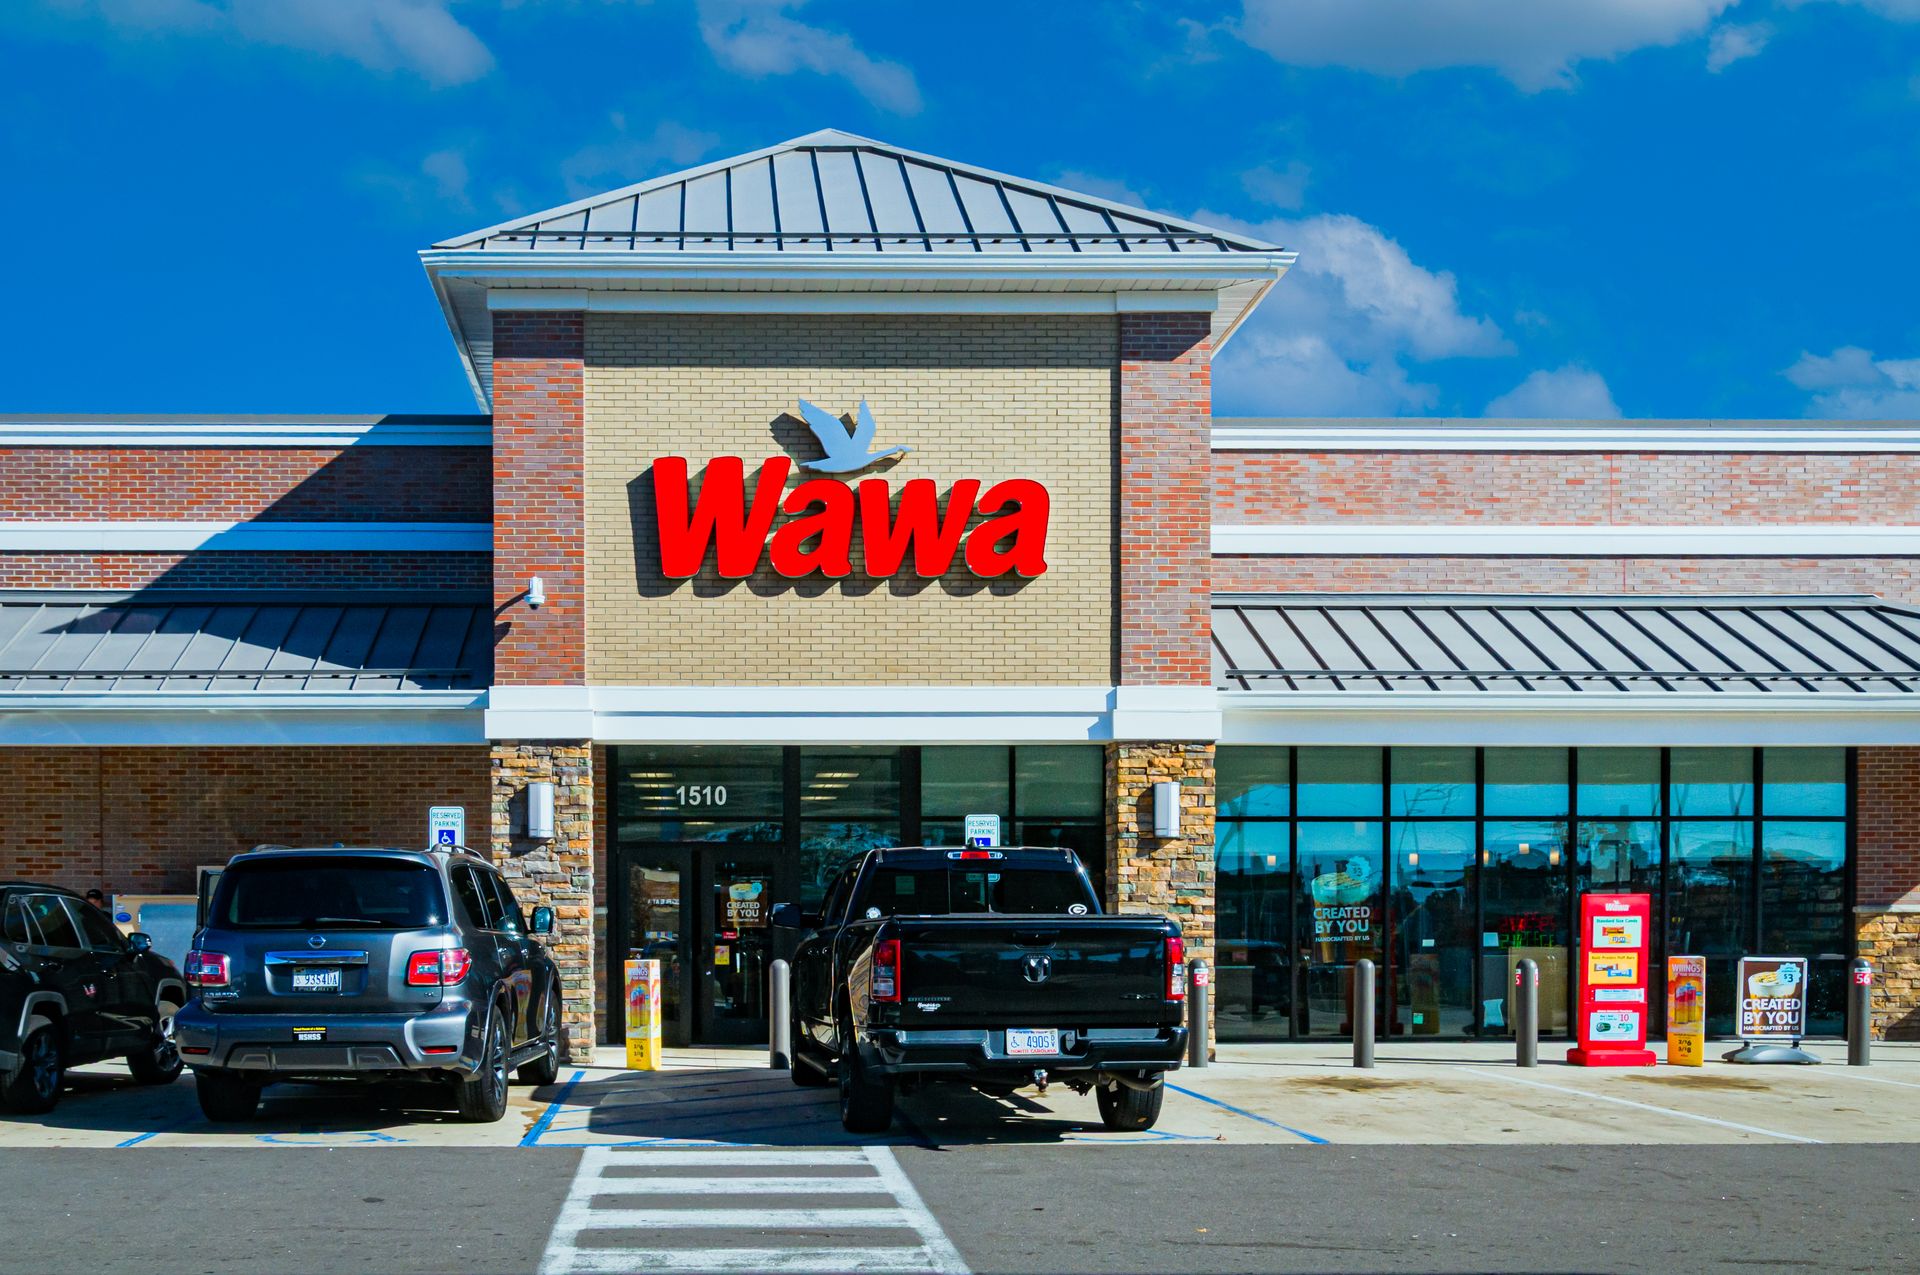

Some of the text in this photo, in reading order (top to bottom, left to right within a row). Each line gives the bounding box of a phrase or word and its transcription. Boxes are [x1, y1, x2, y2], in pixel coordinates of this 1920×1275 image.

[653, 456, 1050, 578] Wawa
[676, 785, 726, 806] 1510
[726, 901, 760, 909] CREATED
[727, 909, 759, 917] BY YOU
[1313, 906, 1371, 919] CREATED
[1315, 919, 1369, 934] BY YOU
[1196, 974, 1208, 985] 54
[1783, 974, 1794, 983] $3
[1856, 973, 1870, 985] 56
[1743, 999, 1801, 1010] CREATED
[1744, 1011, 1799, 1024] BY YOU
